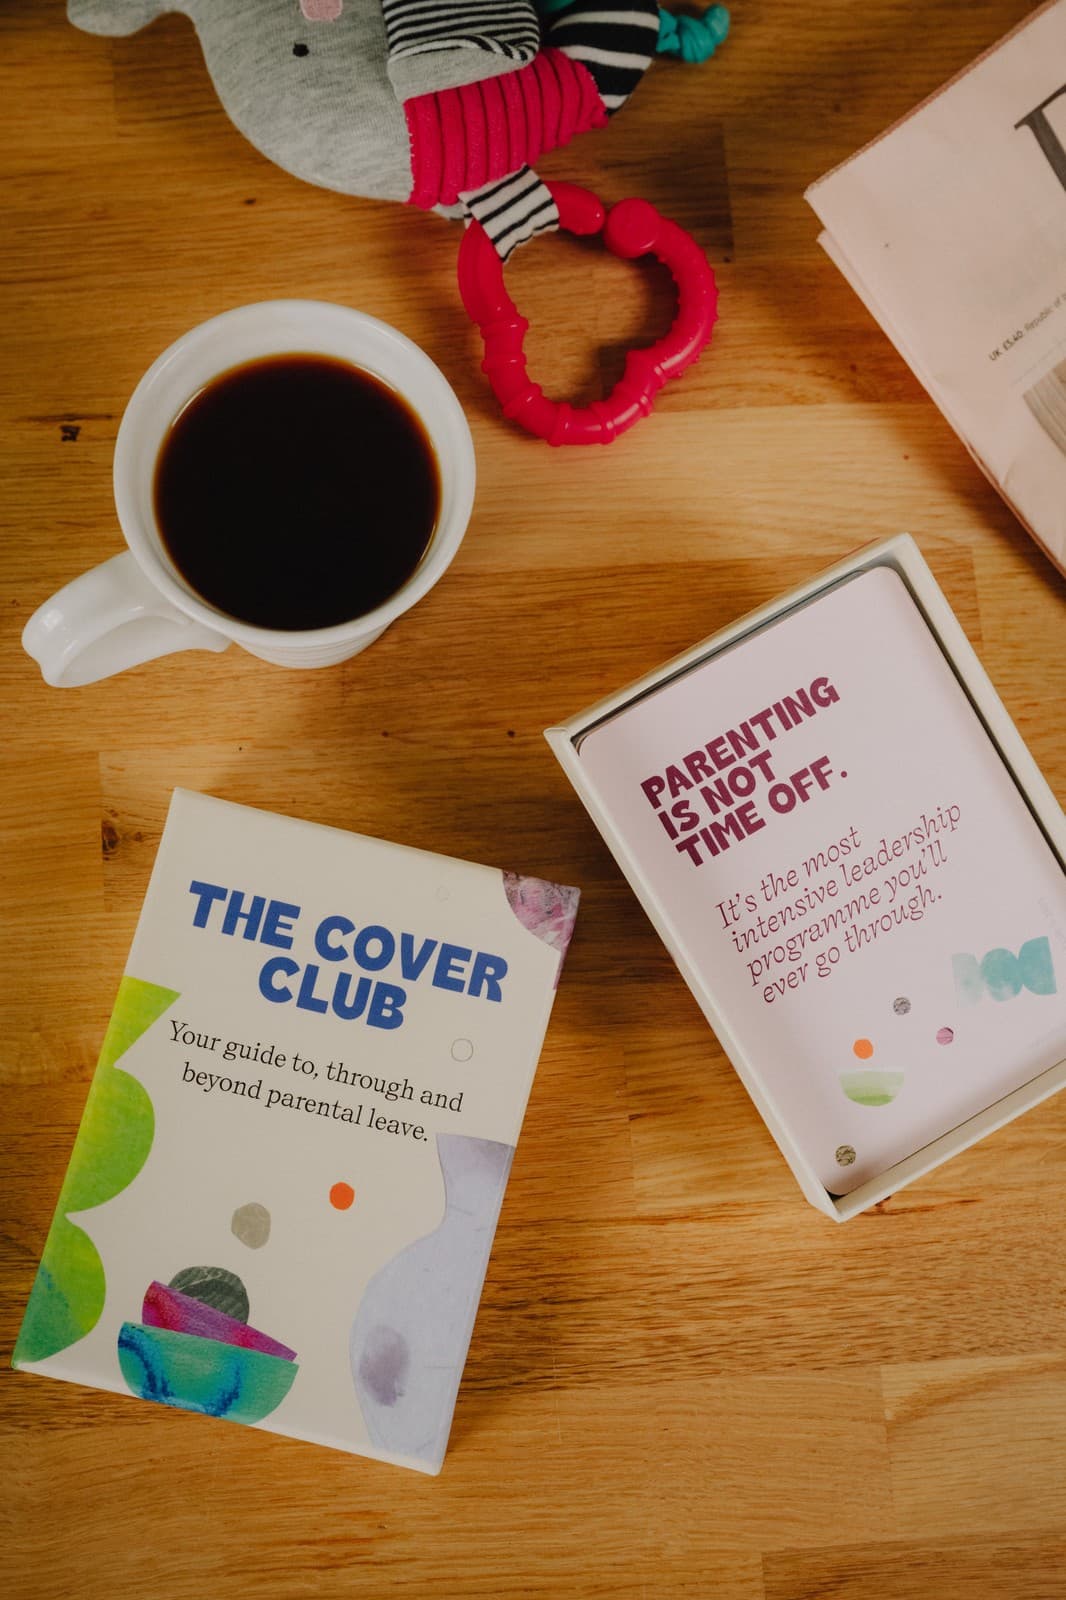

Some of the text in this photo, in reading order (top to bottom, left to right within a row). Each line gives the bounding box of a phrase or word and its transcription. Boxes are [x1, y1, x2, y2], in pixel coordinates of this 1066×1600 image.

[640, 677, 840, 809] PARENTING
[657, 749, 776, 841] IS NOT
[675, 755, 848, 867] TIME OFF.
[714, 826, 862, 930] It's the most
[731, 804, 961, 953] intensive leadership
[747, 840, 948, 987] programme you'll
[189, 879, 509, 1003] THE COVER
[258, 956, 407, 1030] CLUB
[763, 884, 942, 1003] ever go through.
[169, 1020, 464, 1113] Your guide to, through and
[182, 1062, 429, 1142] beyond parental leave.
